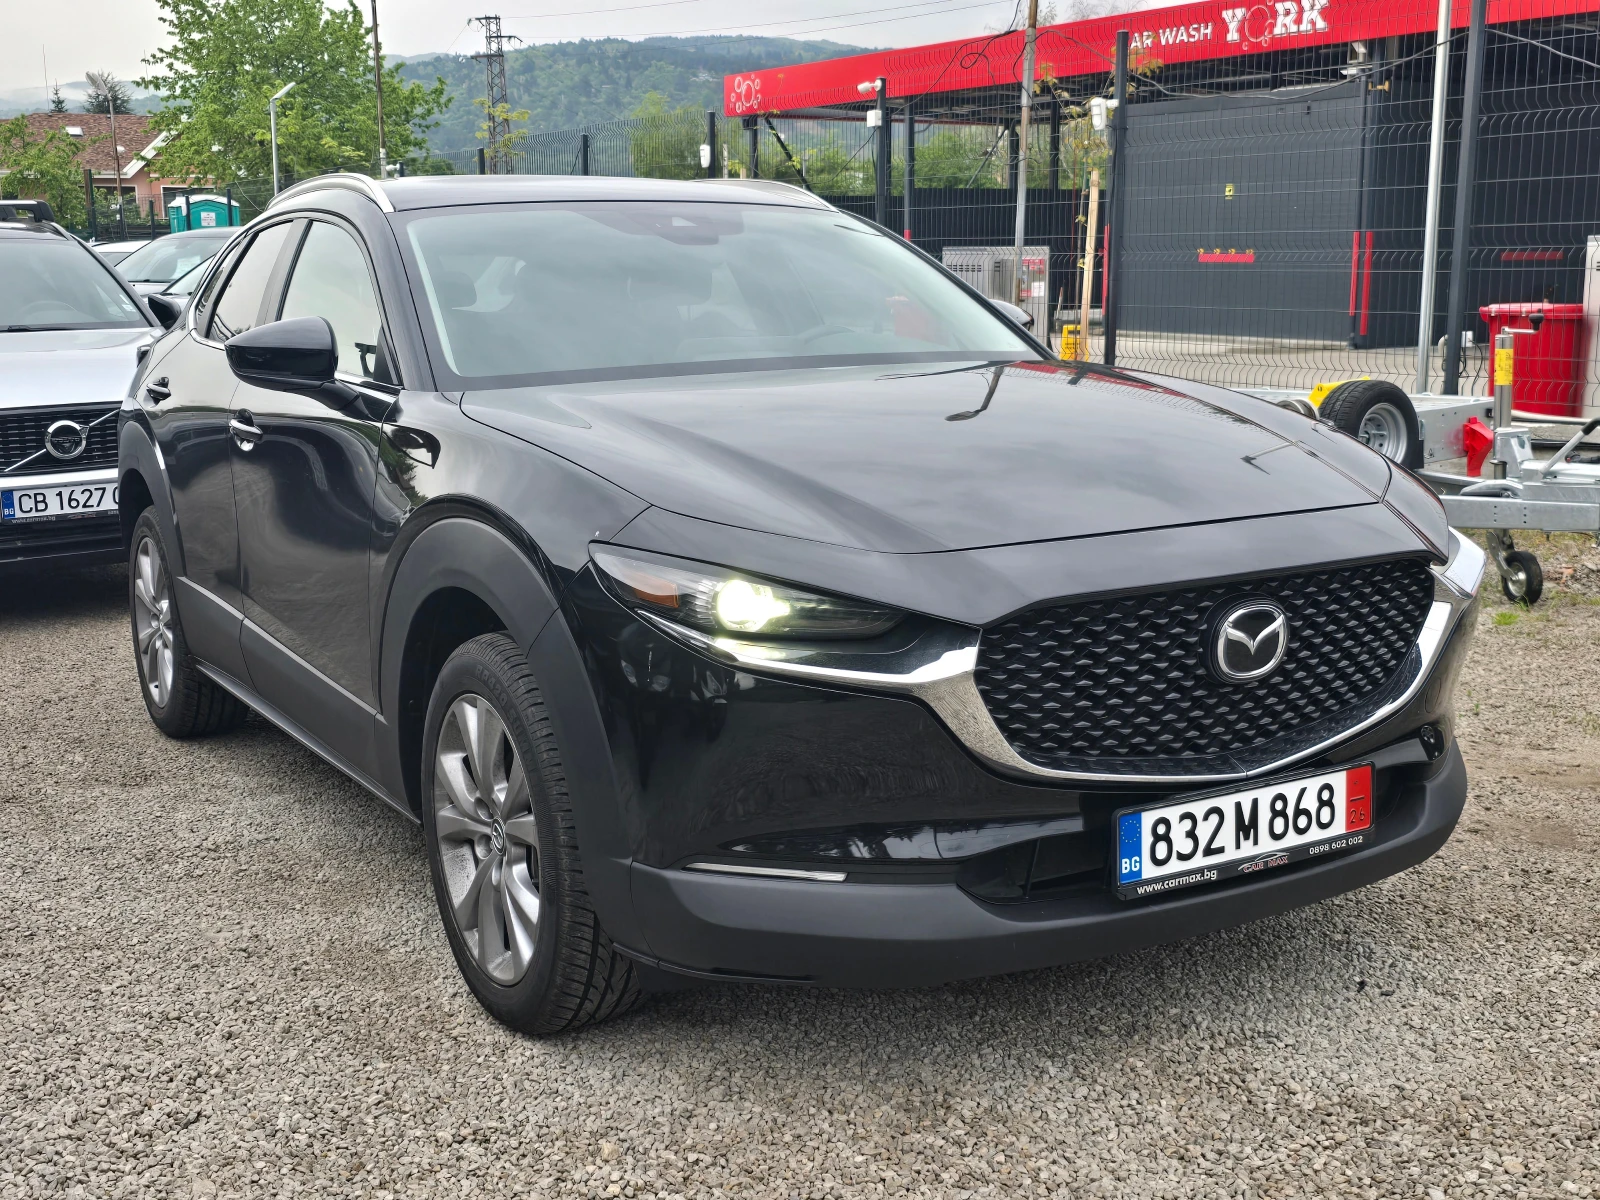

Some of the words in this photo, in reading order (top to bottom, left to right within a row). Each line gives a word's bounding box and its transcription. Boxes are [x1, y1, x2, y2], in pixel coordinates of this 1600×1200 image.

[1130, 31, 1152, 49] AR
[1159, 22, 1212, 46] WASH
[1221, 0, 1329, 43] YORK
[18, 492, 49, 514] CB
[55, 487, 107, 510] 1627
[1149, 805, 1225, 867] 832
[1234, 797, 1259, 850] M
[1268, 782, 1336, 841] 868
[1350, 806, 1366, 825] 26
[1309, 843, 1330, 855] 0898
[1331, 839, 1347, 850] 602
[1348, 835, 1363, 846] 002
[1121, 856, 1140, 874] BG
[1242, 859, 1264, 873] CAR
[1268, 855, 1289, 867] MAX
[1136, 869, 1217, 895] www.carmax.bg
